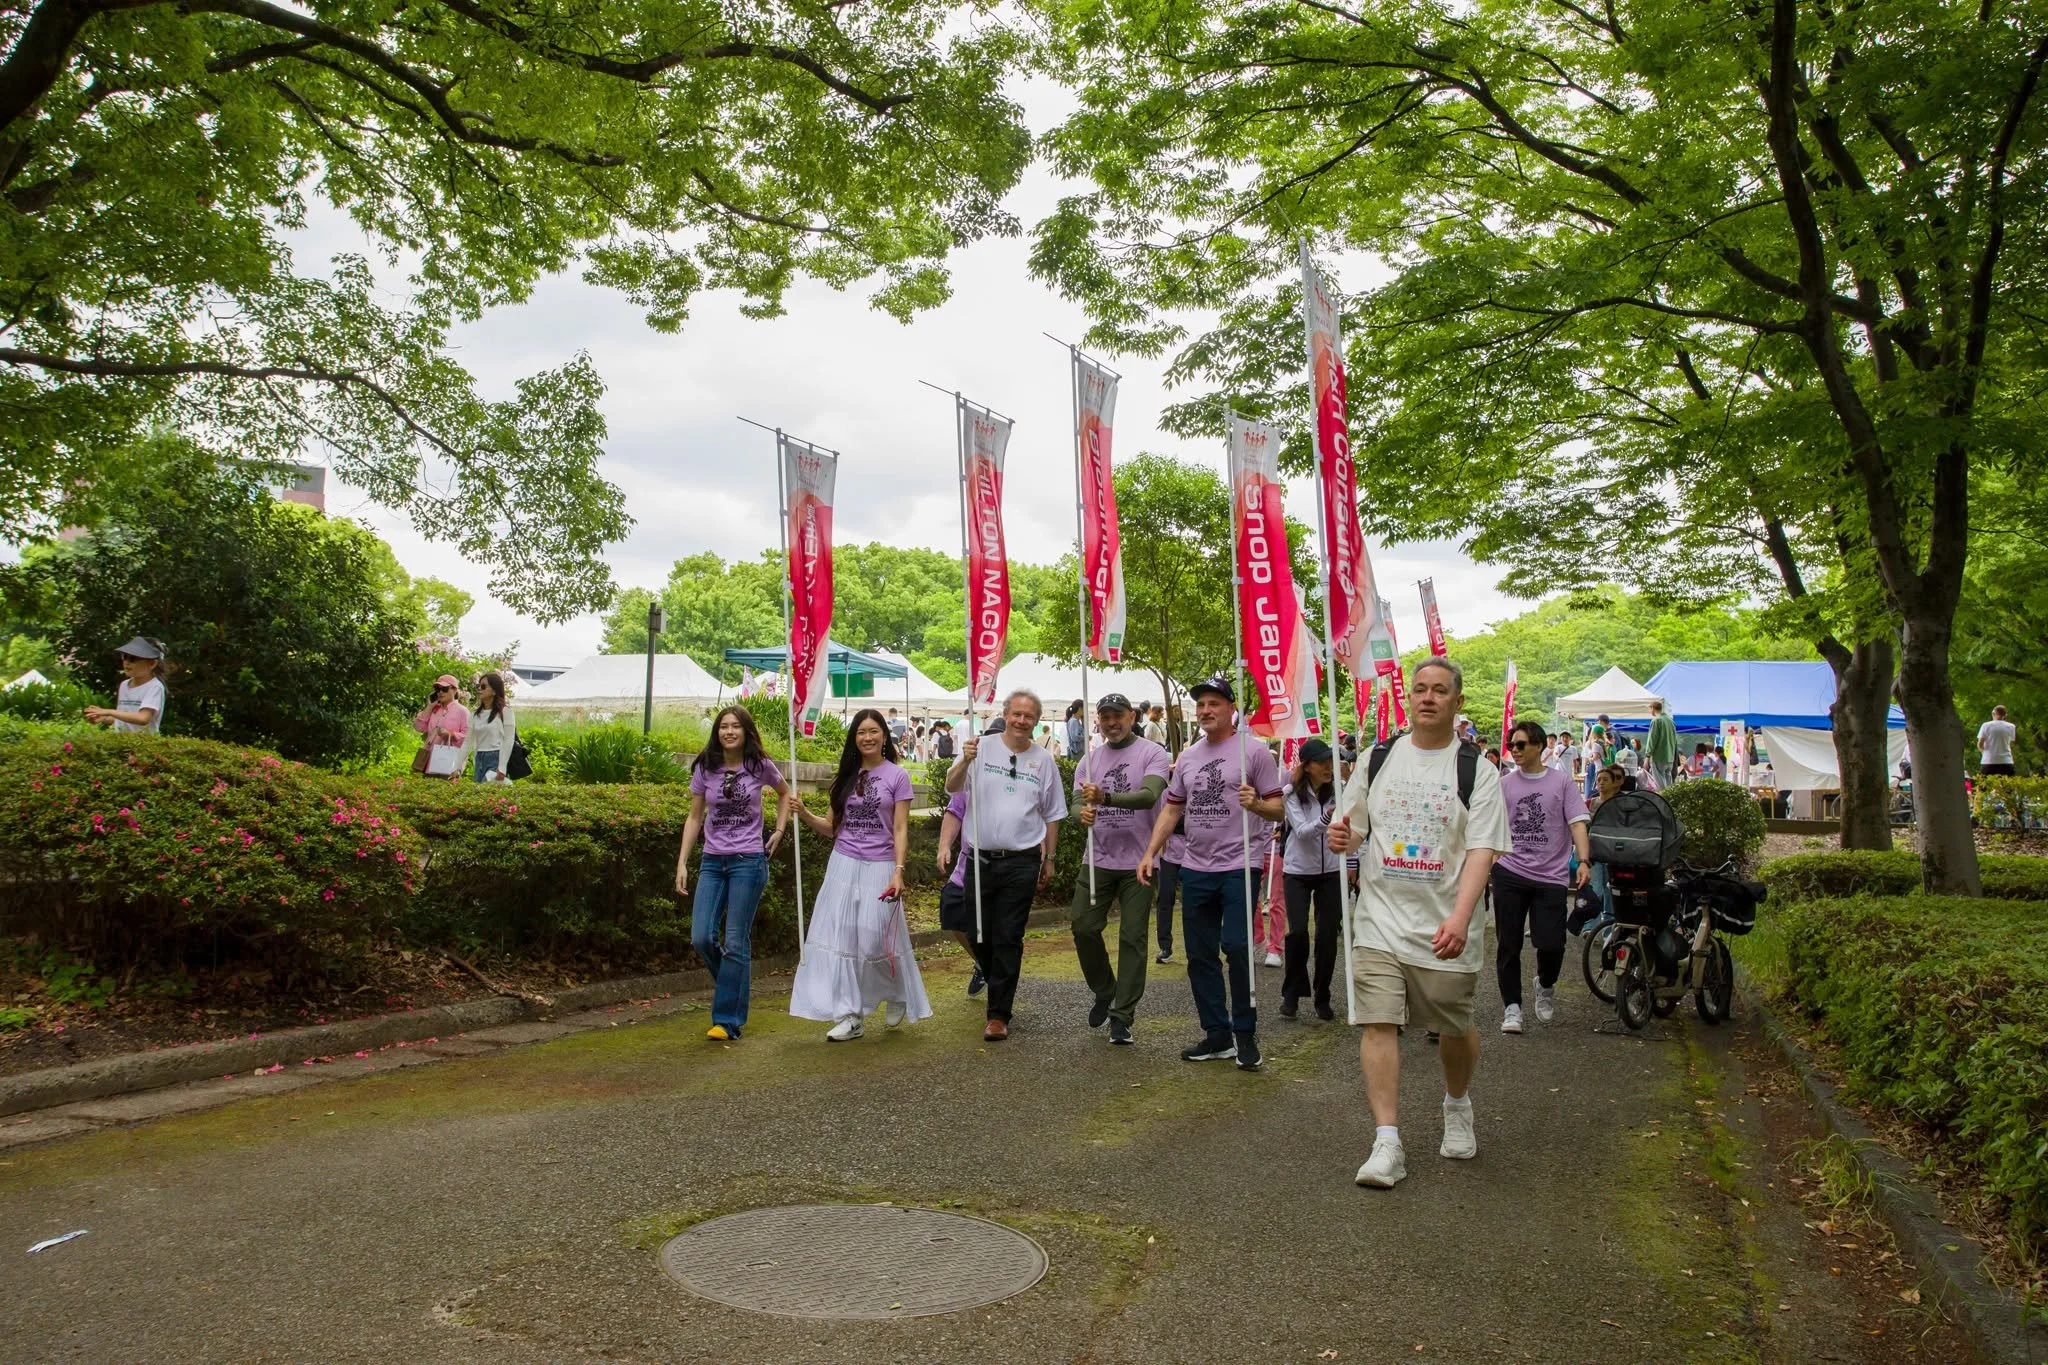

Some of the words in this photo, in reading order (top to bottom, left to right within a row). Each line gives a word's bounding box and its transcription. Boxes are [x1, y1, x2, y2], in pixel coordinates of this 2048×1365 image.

[980, 462, 1000, 561] HILTON
[1089, 429, 1108, 634] Bloomber
[1334, 432, 1356, 657] Consultats
[976, 569, 1001, 687] NAGOYA
[1256, 597, 1293, 721] Japan
[1001, 767, 1029, 776] Intetional
[1382, 857, 1444, 871] Walkathon!
